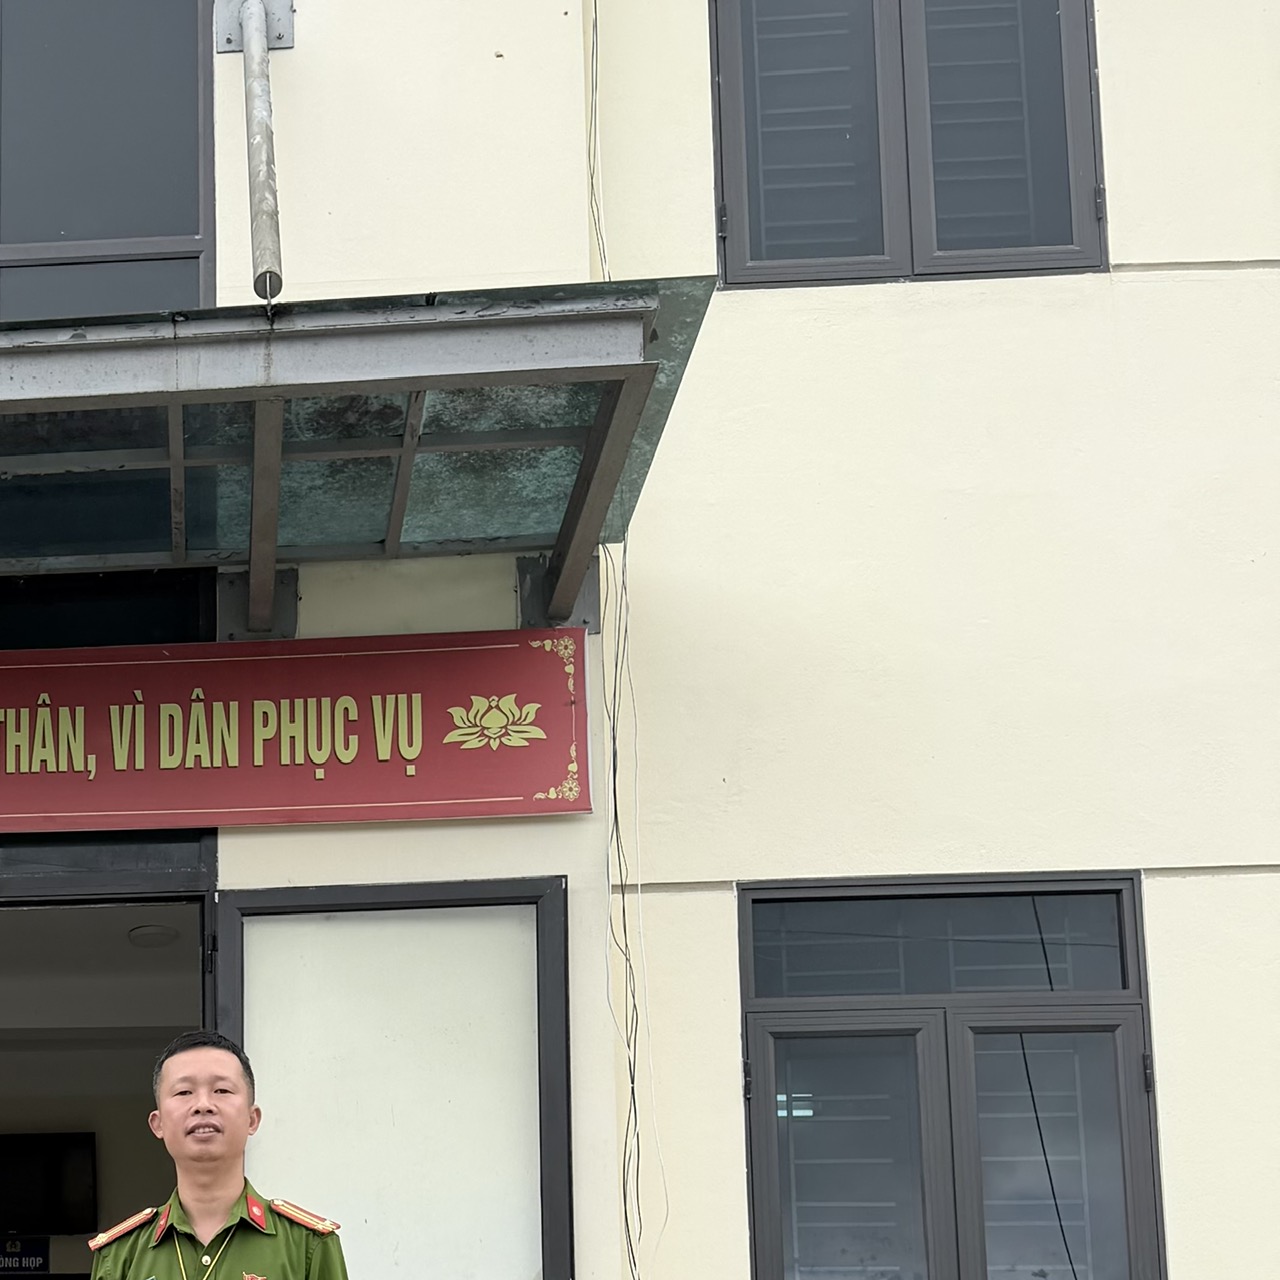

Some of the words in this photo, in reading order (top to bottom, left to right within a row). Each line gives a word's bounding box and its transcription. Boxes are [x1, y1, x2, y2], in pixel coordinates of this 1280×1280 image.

[109, 690, 145, 770] VÌ
[159, 688, 239, 769] DÂN
[253, 695, 359, 779] PHỤC
[371, 693, 423, 776] VỤ
[21, 1256, 43, 1270] HỌP
